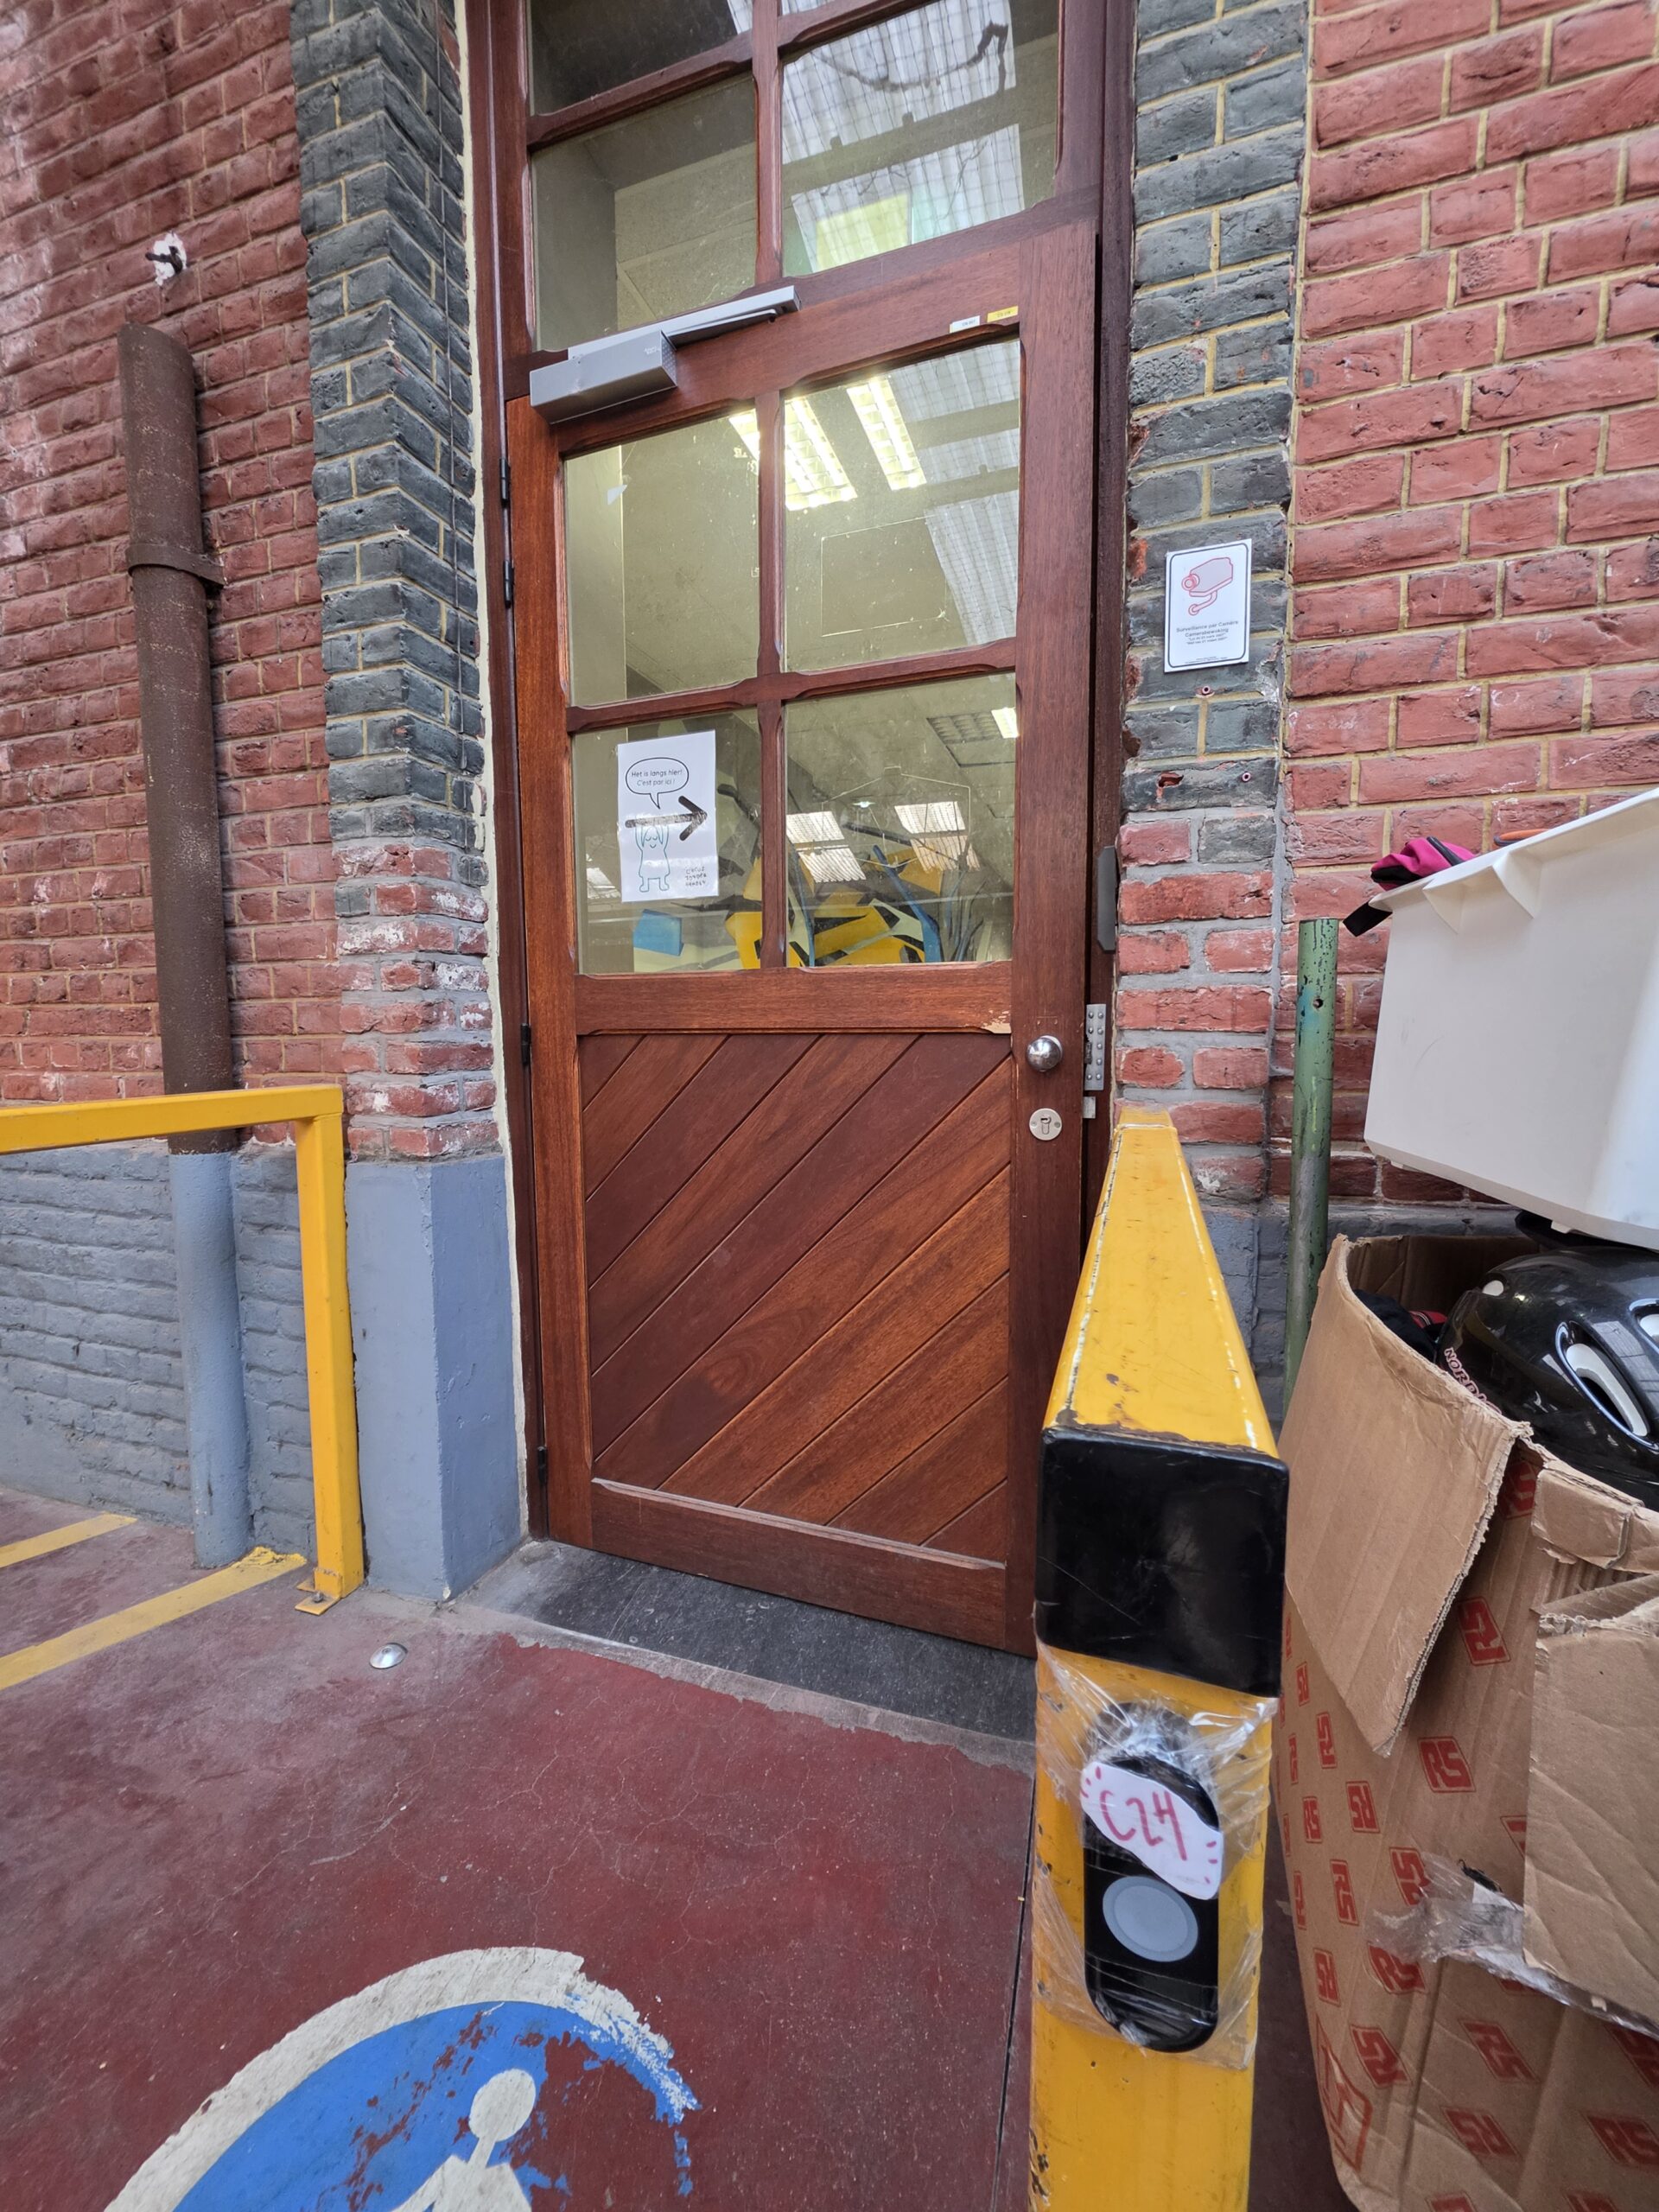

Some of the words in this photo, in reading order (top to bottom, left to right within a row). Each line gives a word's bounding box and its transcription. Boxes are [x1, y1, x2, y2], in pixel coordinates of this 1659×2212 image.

[1420, 1739, 1473, 1789] RS
[1099, 1789, 1188, 1861] C24
[1332, 1861, 1357, 1923] RS
